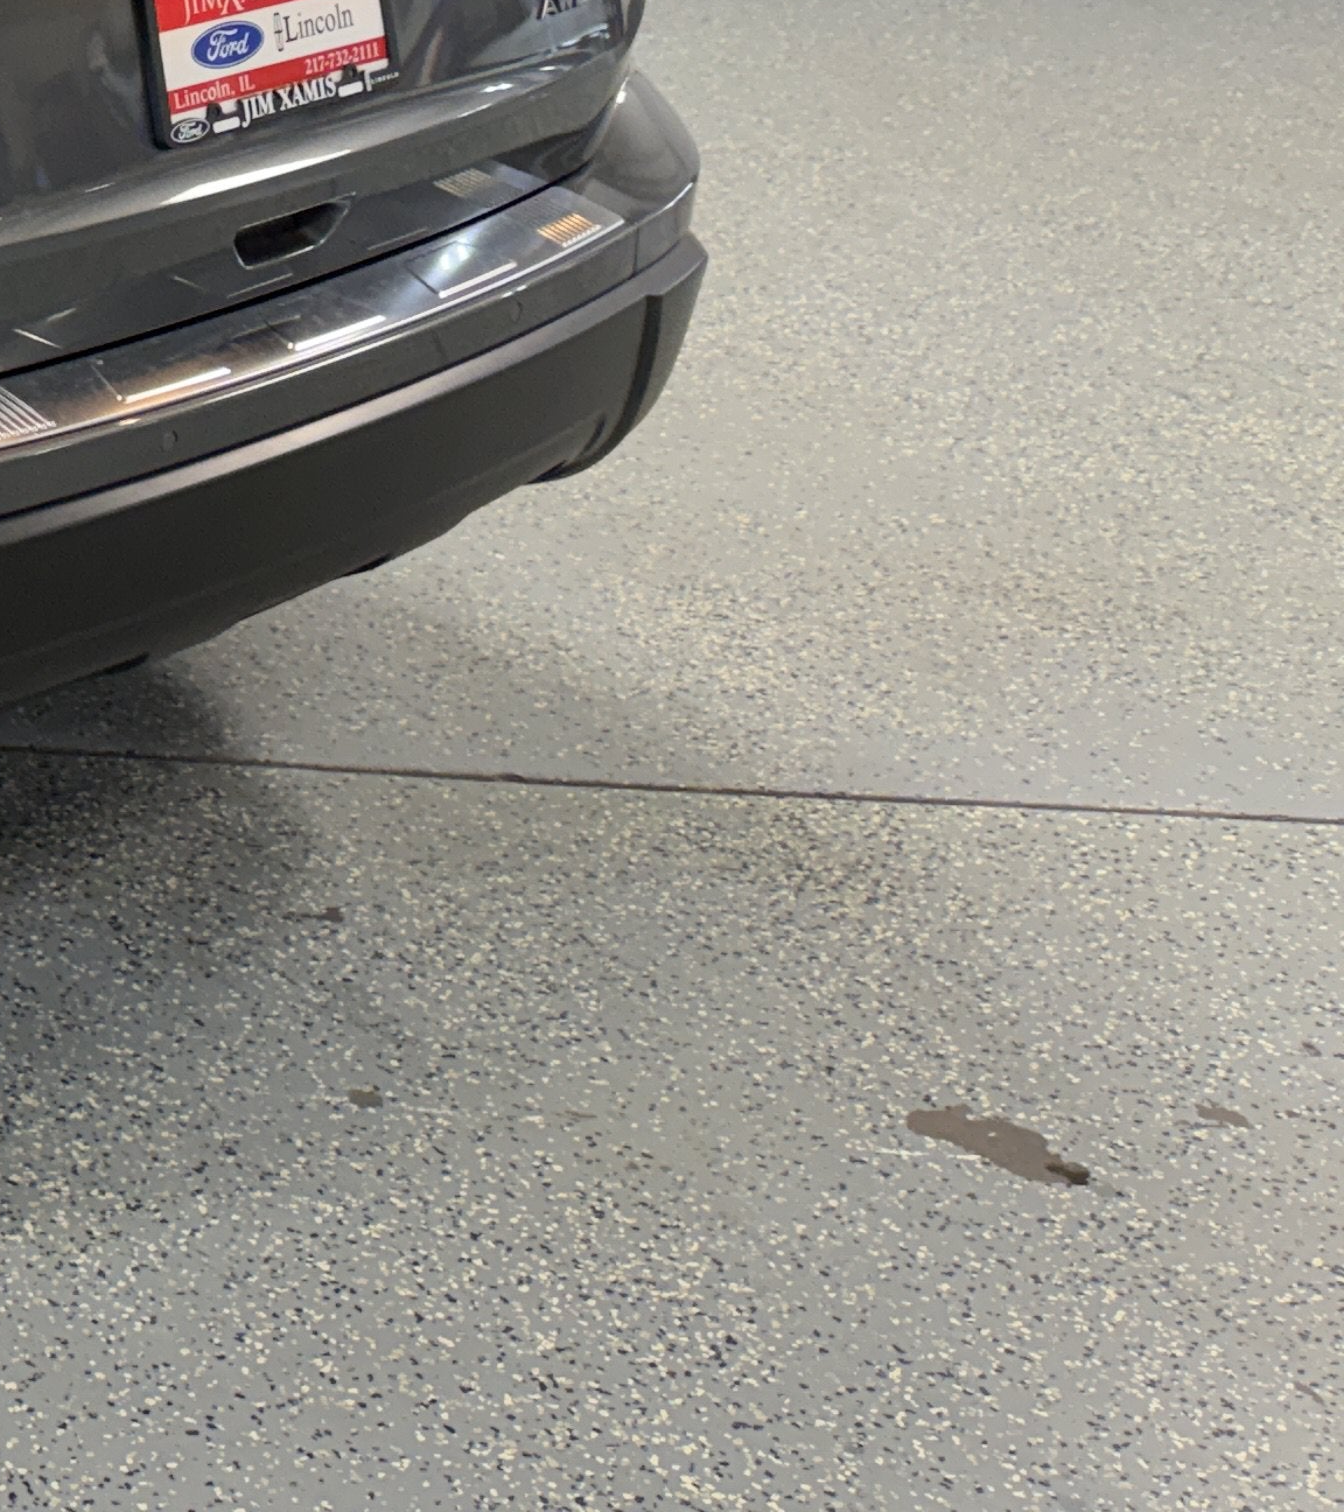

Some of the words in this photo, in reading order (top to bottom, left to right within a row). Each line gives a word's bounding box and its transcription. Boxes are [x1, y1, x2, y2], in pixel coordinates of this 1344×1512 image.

[283, 3, 354, 42] Lincoln
[207, 28, 250, 61] Ford
[304, 41, 380, 76] 217-732-2111
[237, 74, 257, 93] IL
[241, 92, 278, 129] JIM
[276, 75, 337, 112] XAMIS
